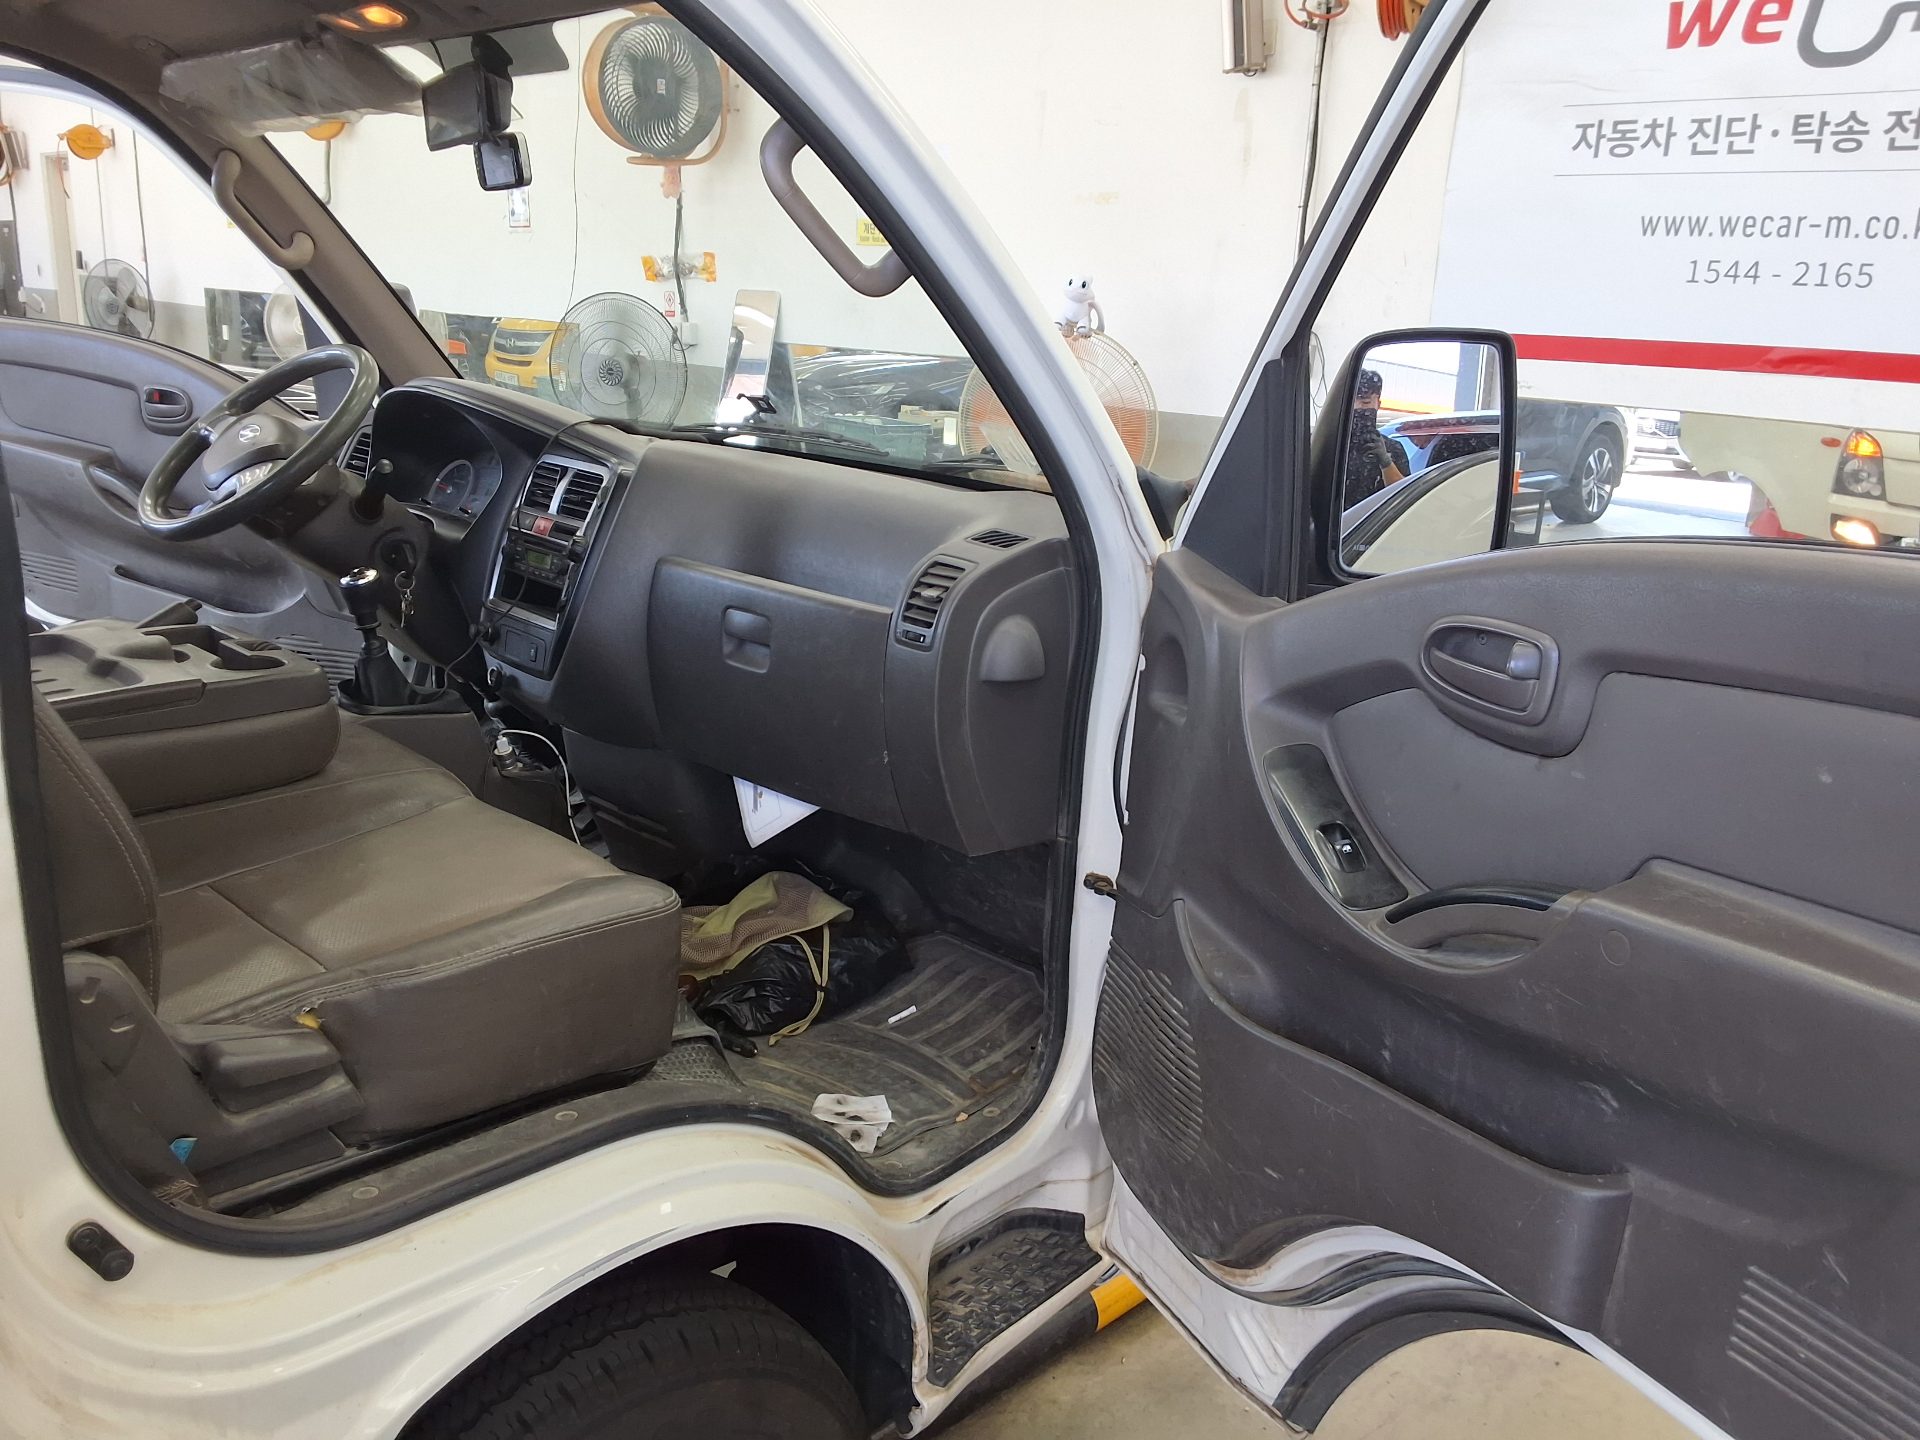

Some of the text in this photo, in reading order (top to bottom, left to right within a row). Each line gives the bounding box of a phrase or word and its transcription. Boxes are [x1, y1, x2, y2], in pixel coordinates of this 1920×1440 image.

[1571, 116, 1677, 158] 자동차
[1685, 259, 1761, 285] 1544
[1791, 261, 1875, 289] 2165
